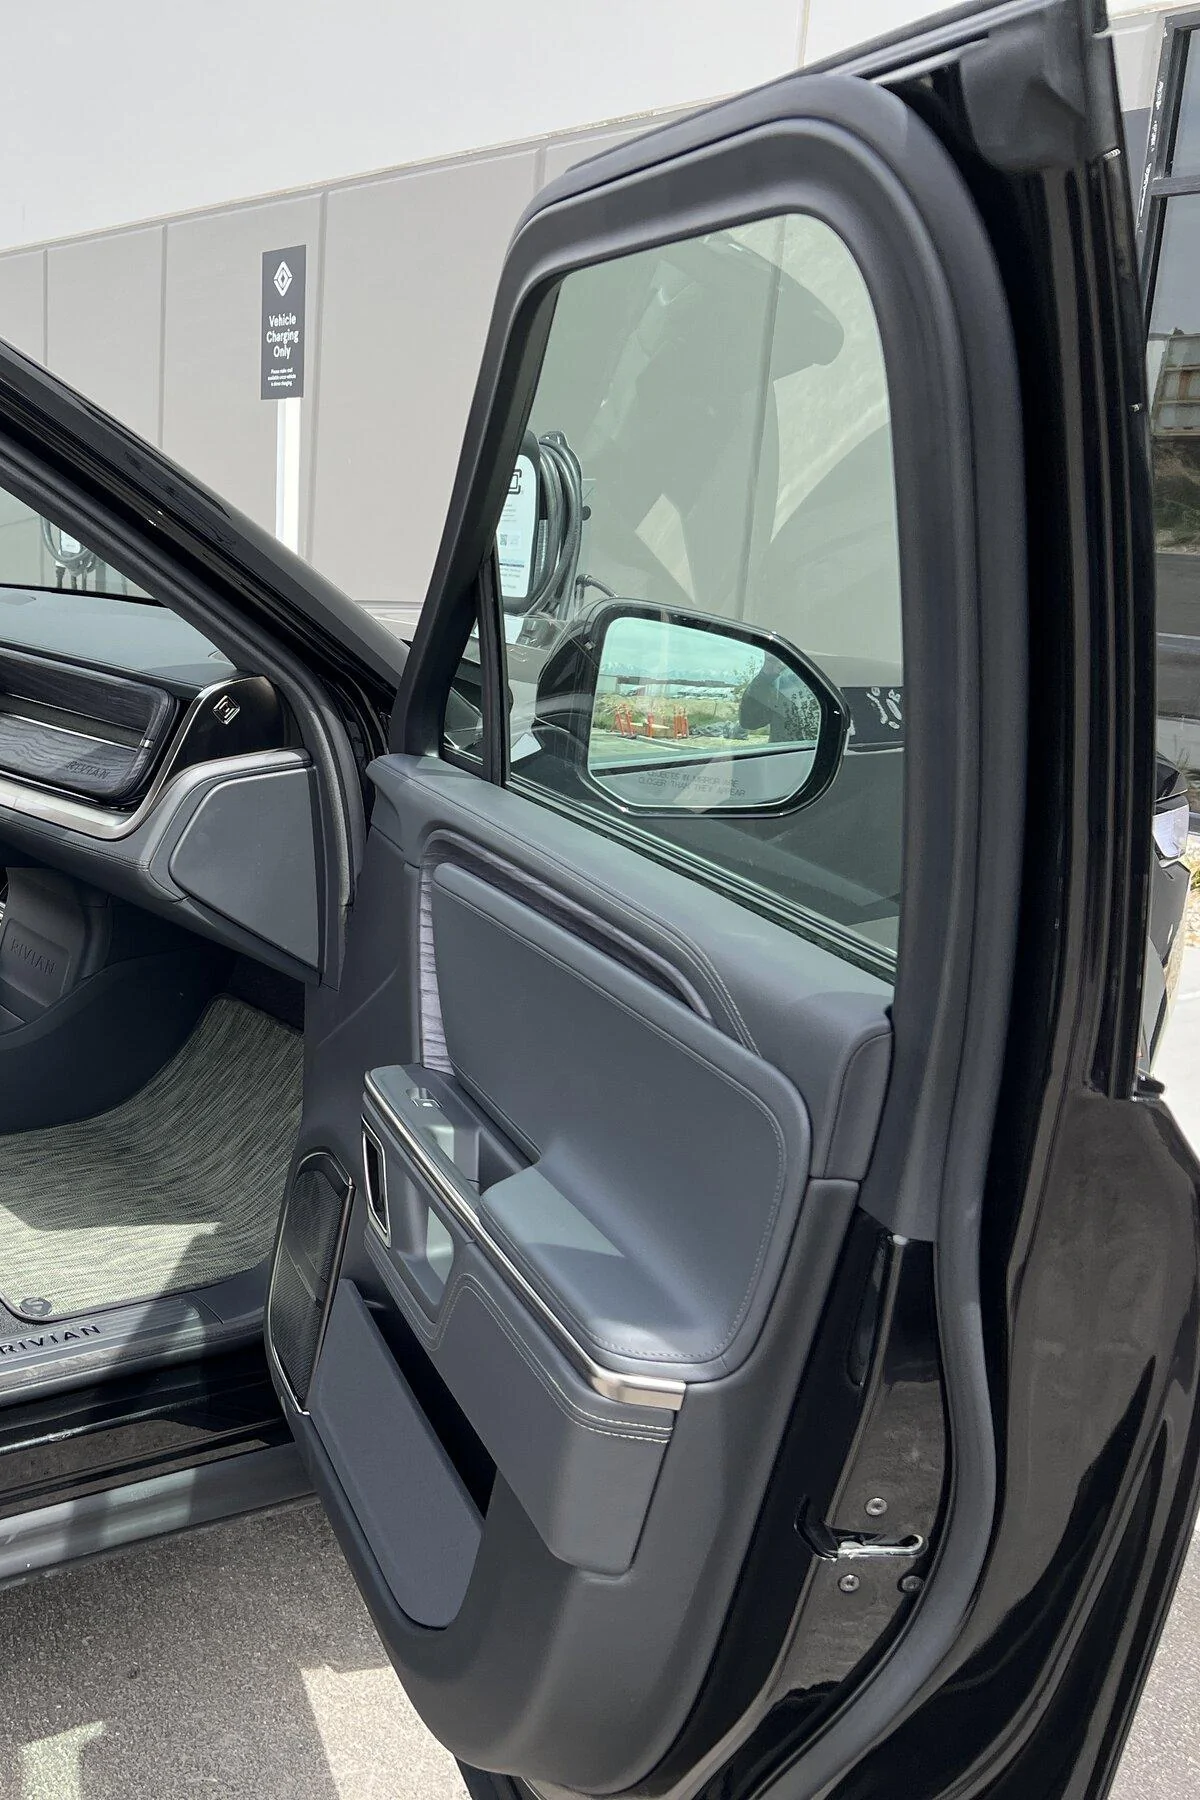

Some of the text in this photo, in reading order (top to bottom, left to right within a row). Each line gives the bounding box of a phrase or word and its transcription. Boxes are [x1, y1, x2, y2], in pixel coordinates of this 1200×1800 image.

[269, 313, 297, 328] Vehicle
[266, 329, 299, 345] Charging
[273, 345, 291, 360] Only
[66, 760, 110, 779] RIVIAN
[10, 937, 56, 974] RIVIAN
